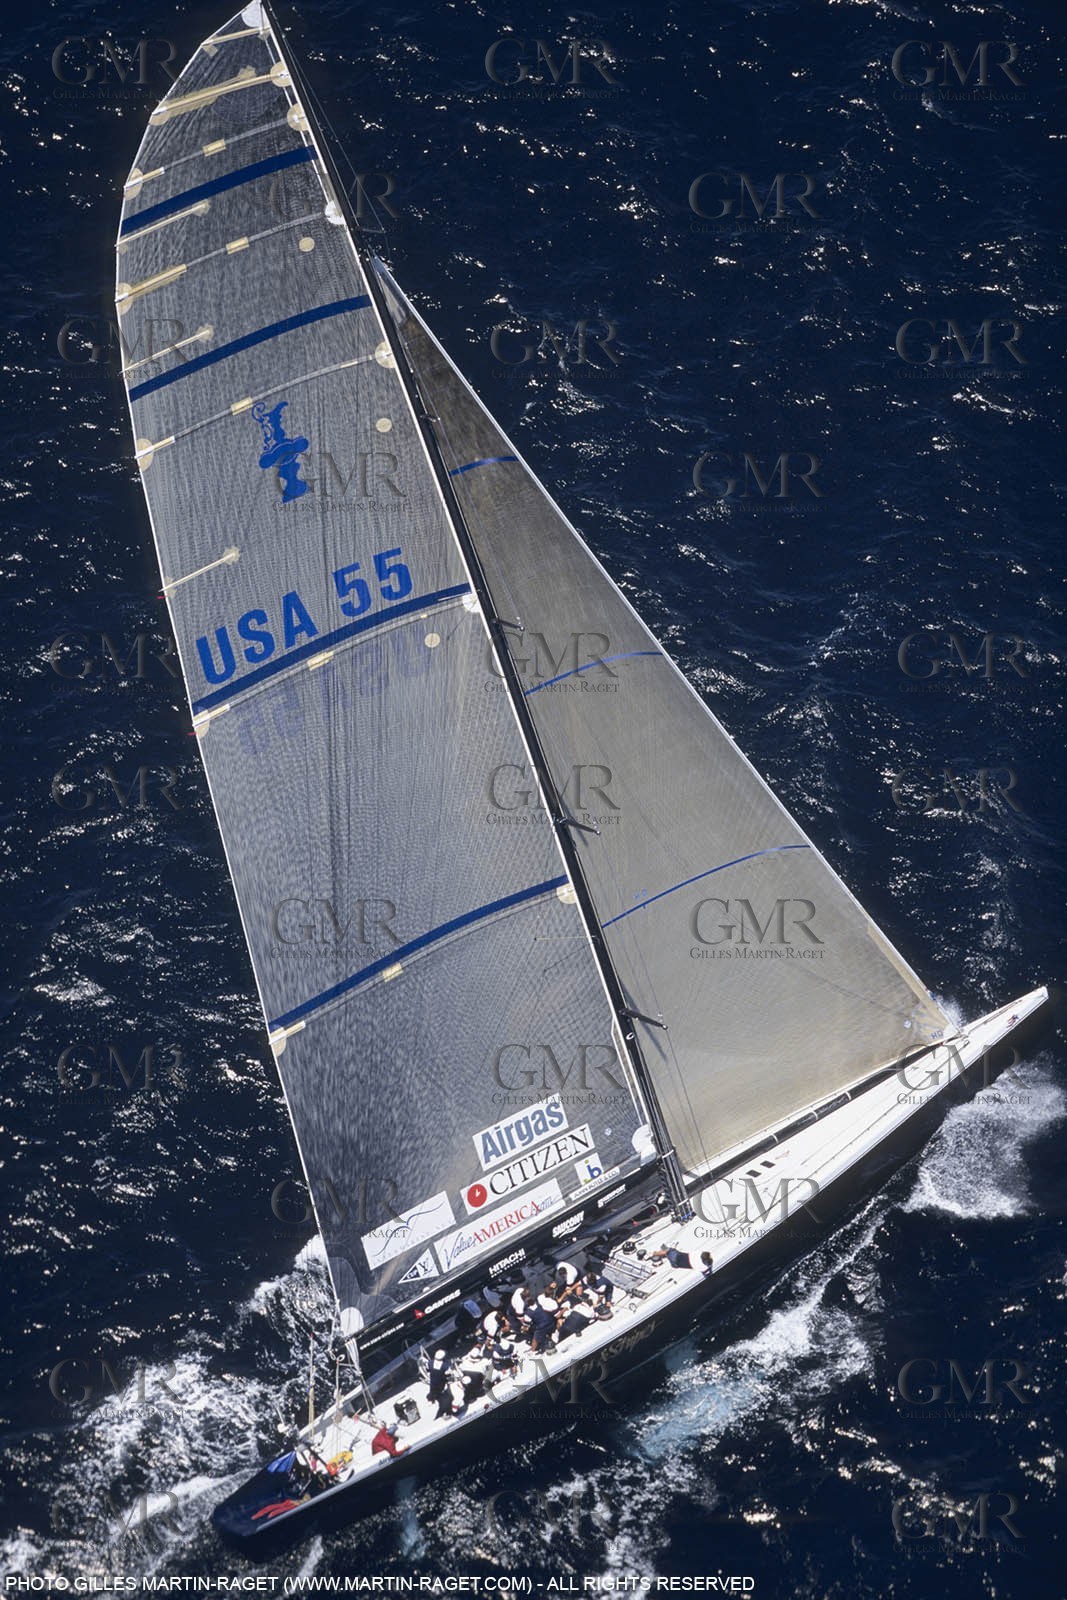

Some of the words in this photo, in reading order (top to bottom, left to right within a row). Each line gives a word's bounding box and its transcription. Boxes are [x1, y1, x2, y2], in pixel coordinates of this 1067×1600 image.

[196, 591, 319, 685] USA
[332, 547, 413, 618] 55
[481, 1099, 565, 1165] Airgas
[490, 1128, 592, 1196] CITIZEN
[552, 1210, 585, 1238] SAUCONY
[488, 1248, 526, 1275] HITACHI
